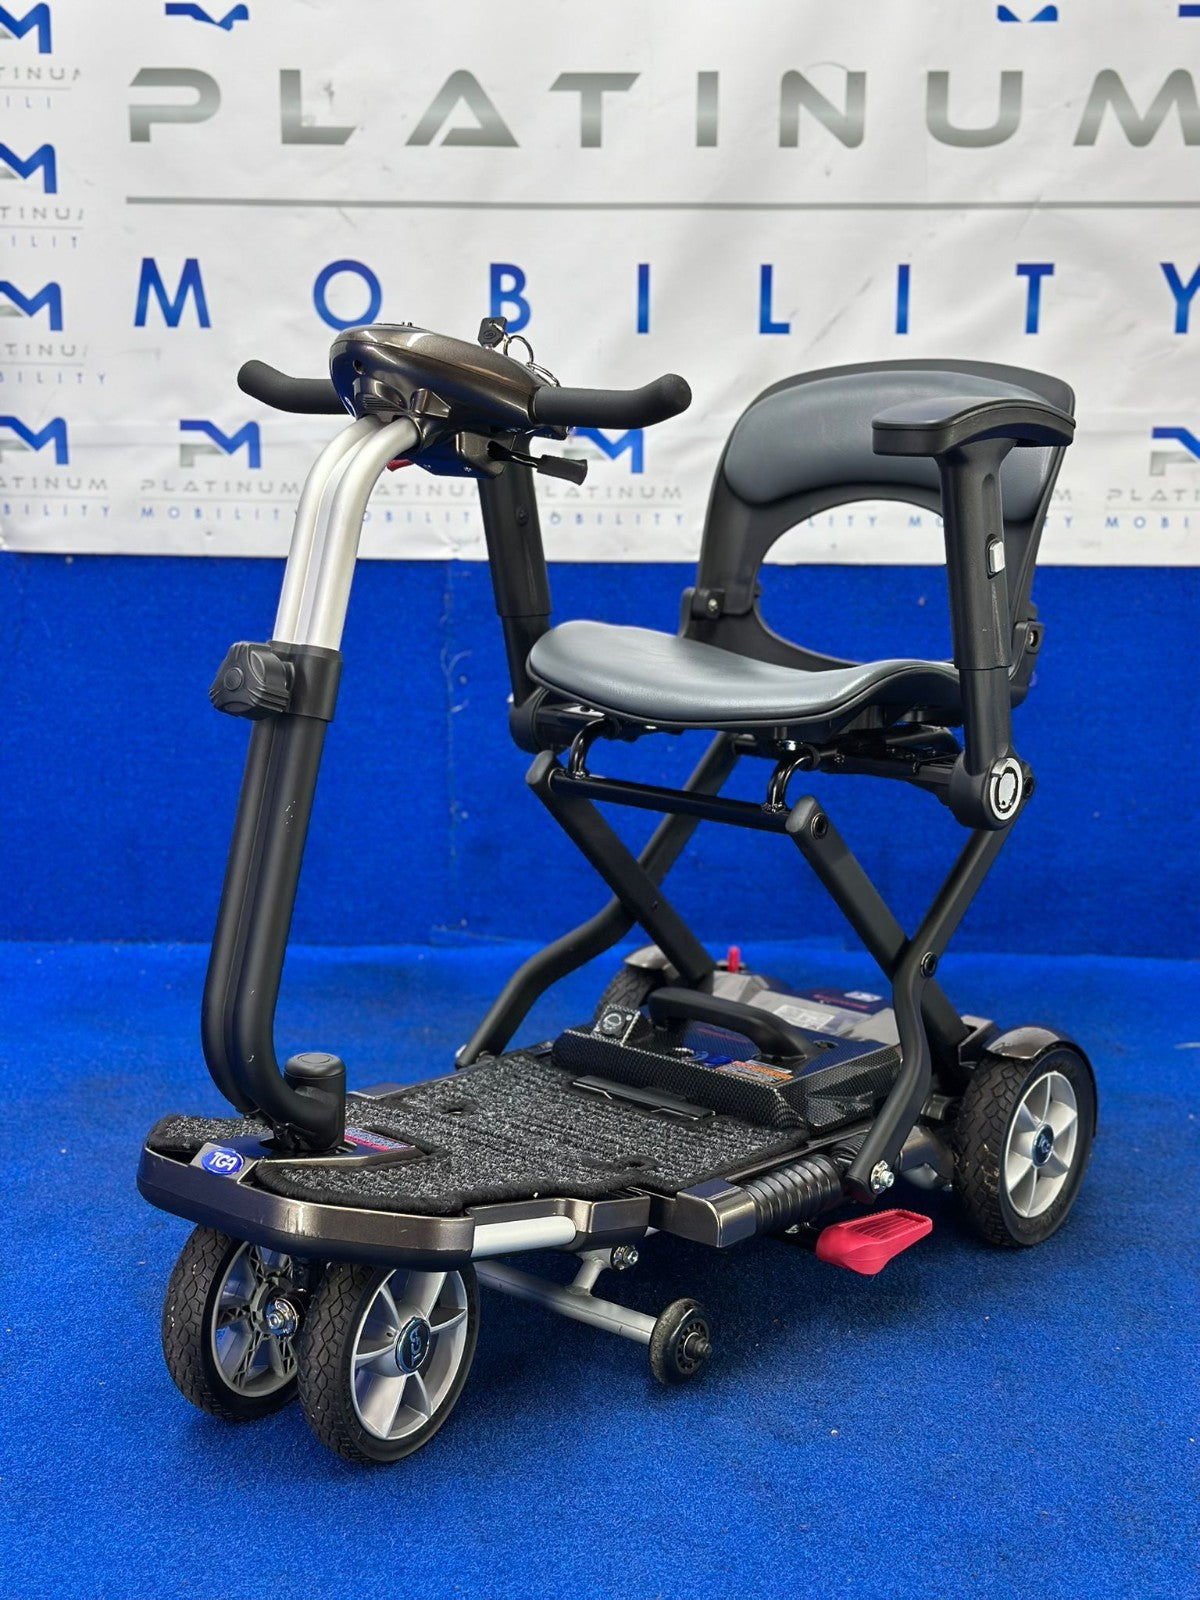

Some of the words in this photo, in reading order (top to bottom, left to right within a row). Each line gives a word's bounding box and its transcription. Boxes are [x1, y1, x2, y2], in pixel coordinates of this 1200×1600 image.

[128, 66, 1200, 148] PLATINUM
[134, 257, 1200, 335] MOBILITY
[140, 506, 298, 521] MOBILIT
[209, 1151, 238, 1171] TGA
